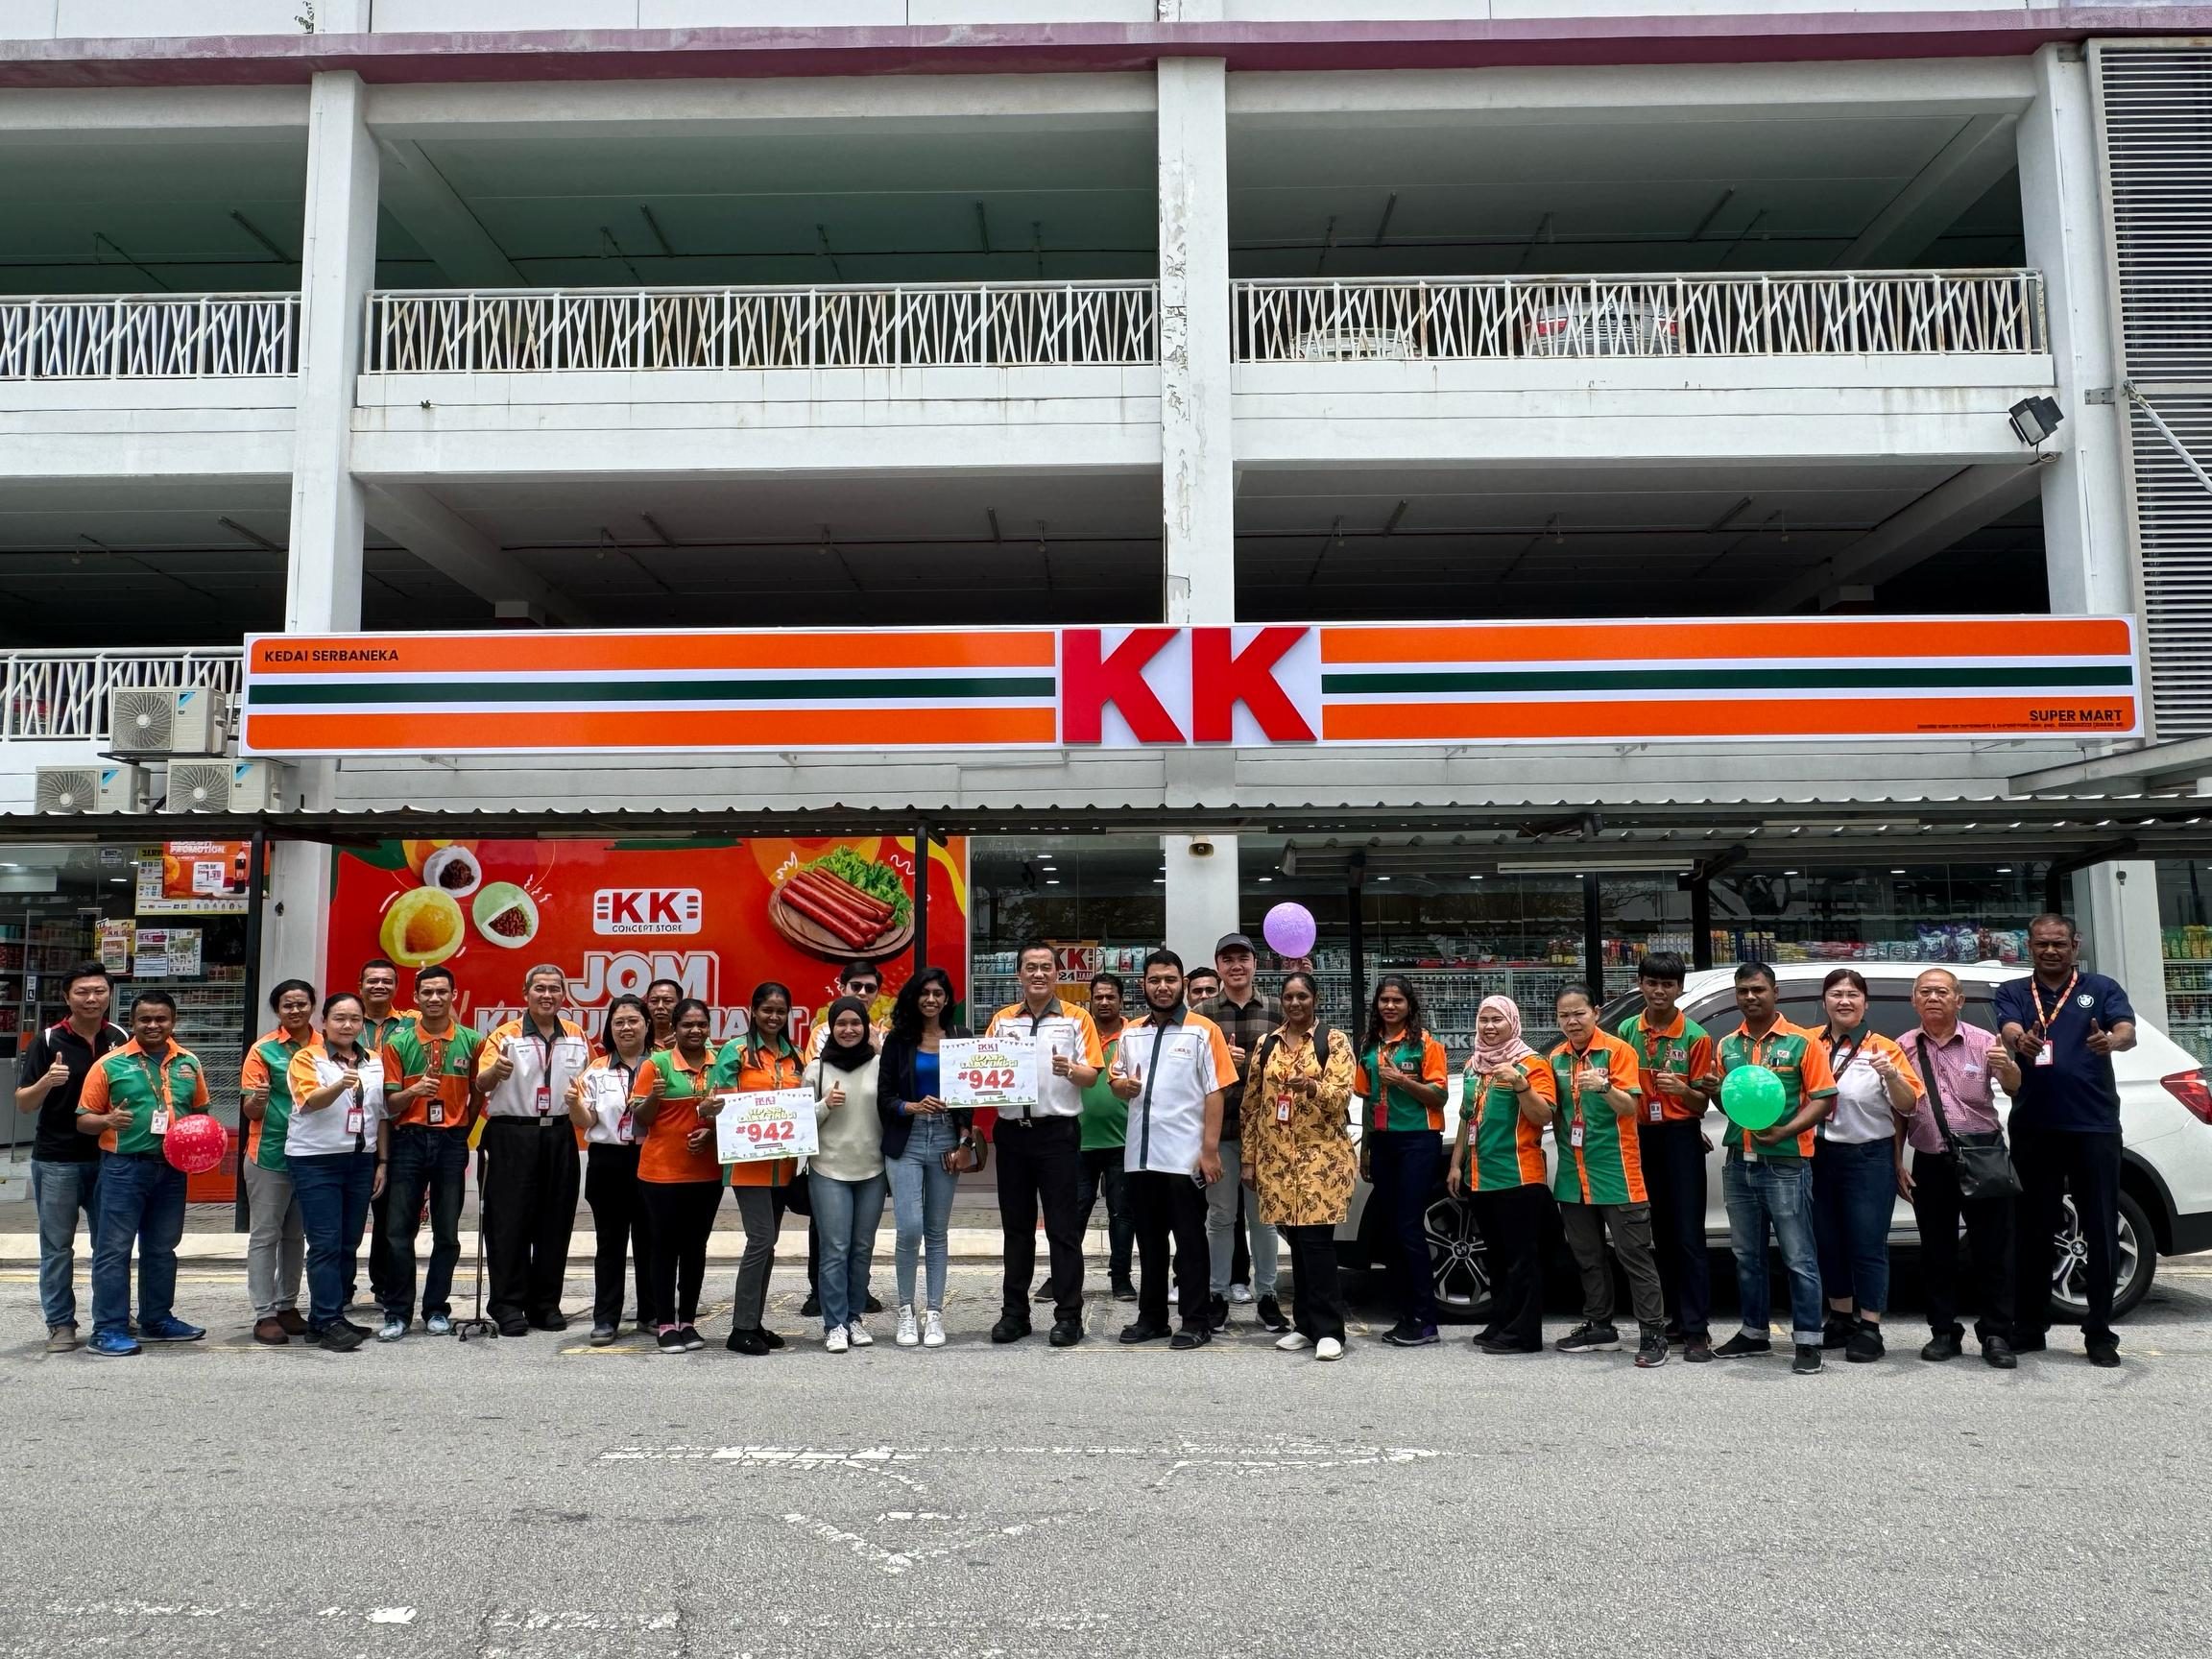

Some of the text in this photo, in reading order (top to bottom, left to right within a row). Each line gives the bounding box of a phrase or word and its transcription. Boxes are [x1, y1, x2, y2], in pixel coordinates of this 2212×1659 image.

[265, 649, 398, 662] KEDAI SERBANEKA
[1062, 627, 1317, 743] KK
[2030, 709, 2123, 722] SUPER MART
[612, 892, 683, 924] KK
[613, 925, 683, 933] CONCEPT STORE
[569, 955, 709, 1002] JOM
[958, 1069, 1016, 1090] #942
[735, 1120, 796, 1143] #942
